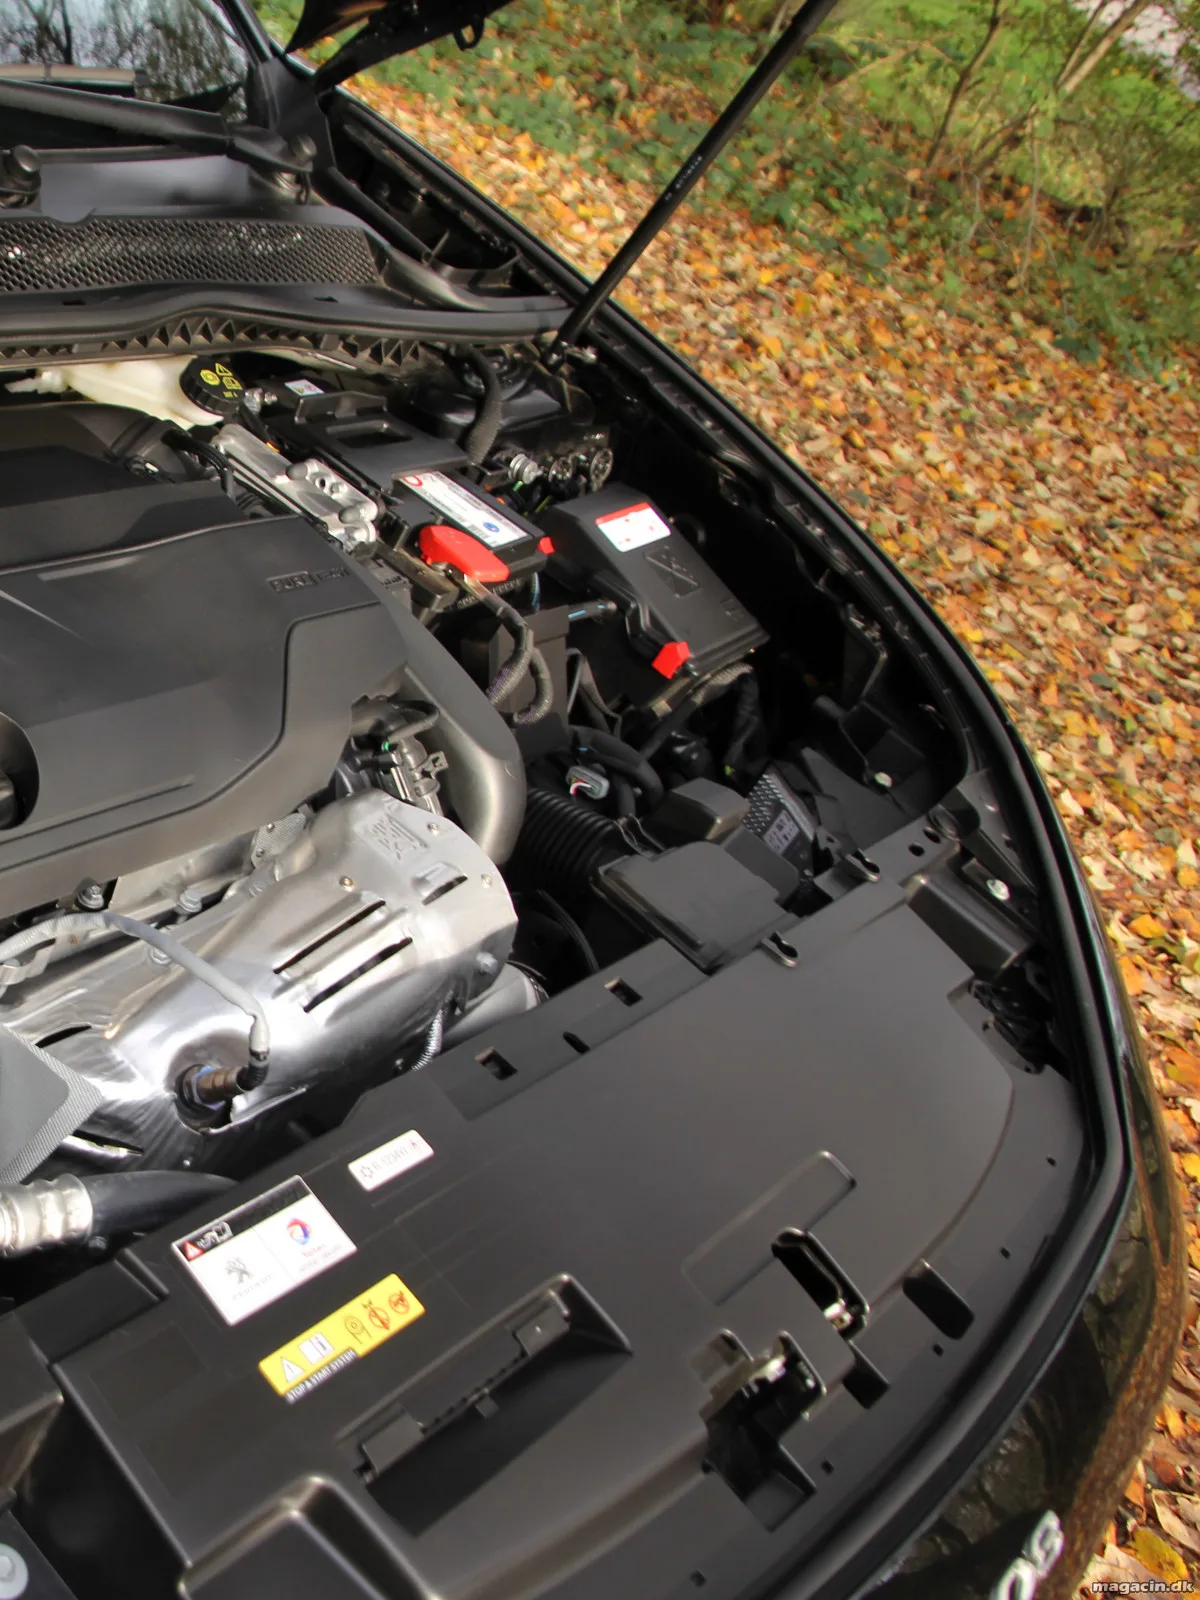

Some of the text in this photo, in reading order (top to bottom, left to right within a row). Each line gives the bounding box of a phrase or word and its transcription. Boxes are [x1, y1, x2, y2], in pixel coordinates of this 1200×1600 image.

[286, 1383, 305, 1404] STOP
[309, 1366, 333, 1388] START
[329, 1348, 357, 1375] SYSTEM
